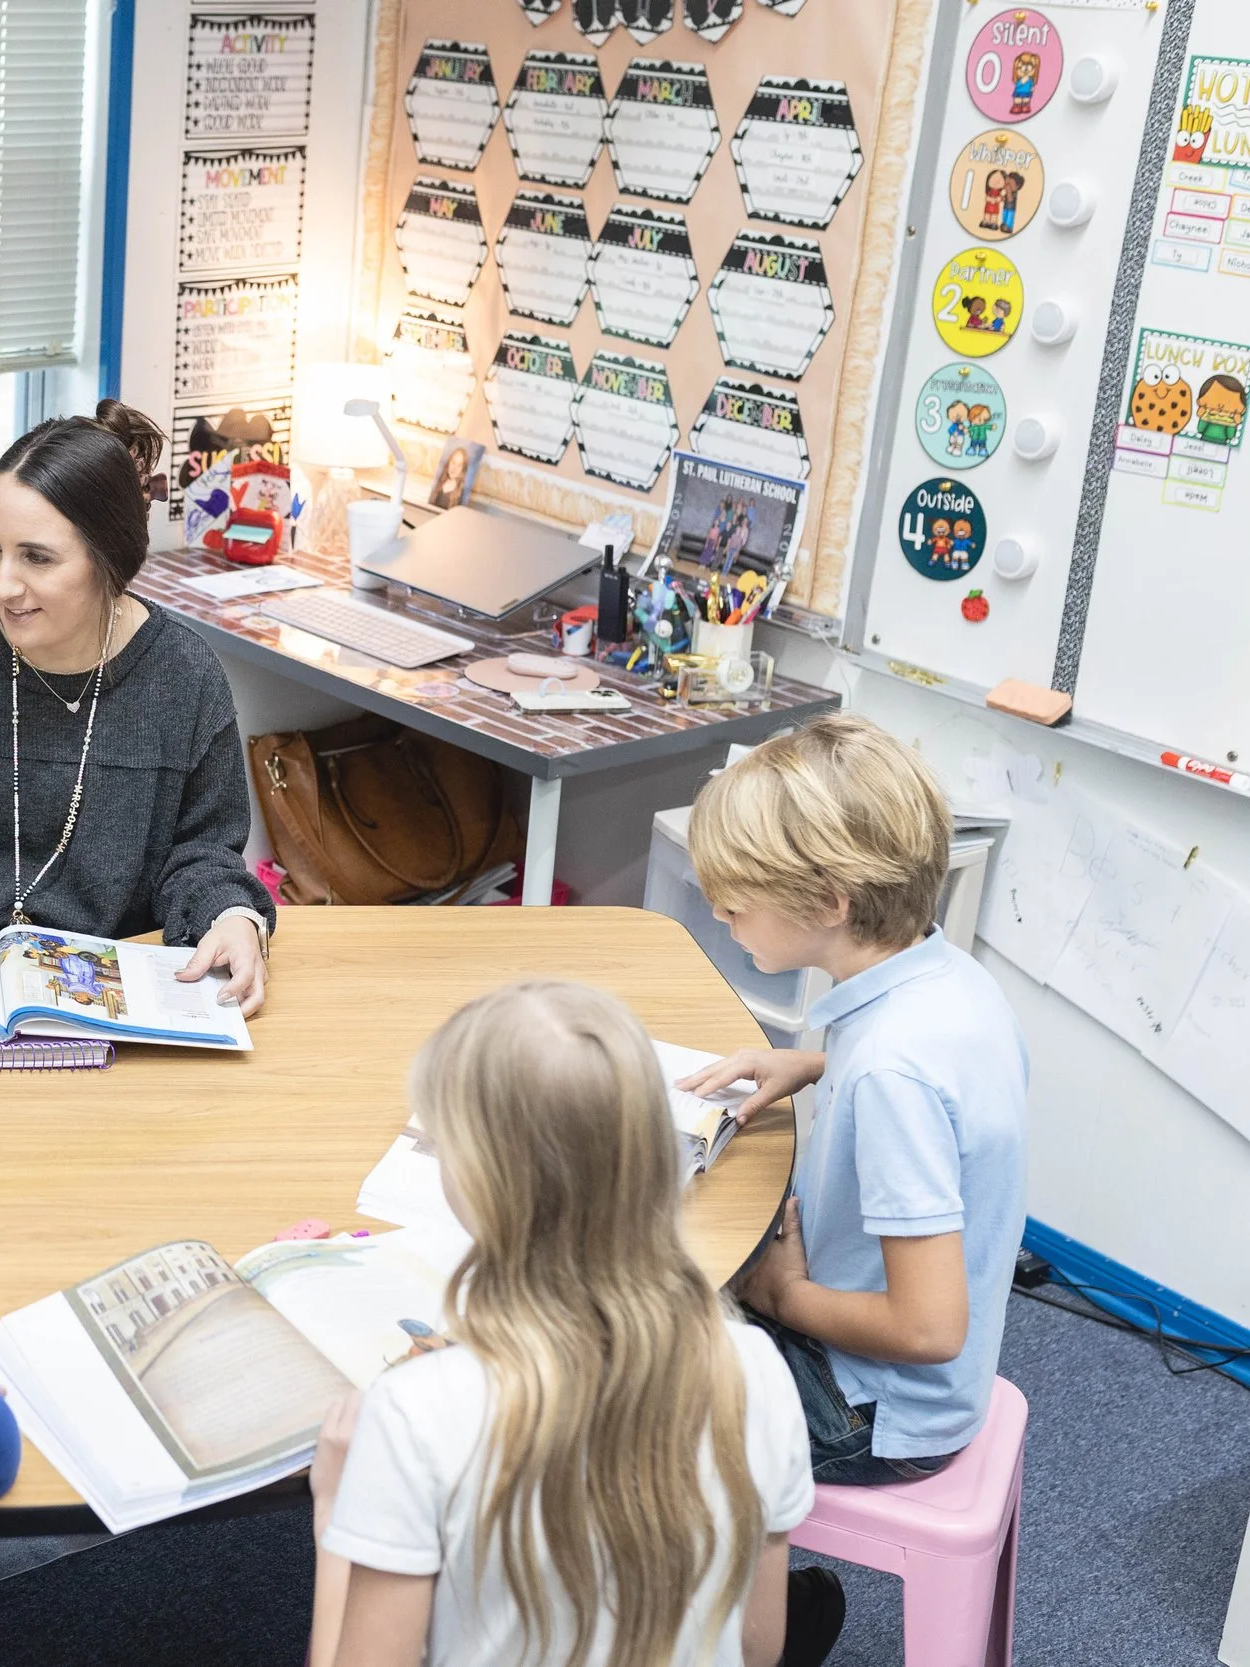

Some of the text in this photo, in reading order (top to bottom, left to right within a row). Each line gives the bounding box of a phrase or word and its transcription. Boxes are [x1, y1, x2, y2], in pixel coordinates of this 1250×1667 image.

[220, 33, 287, 54] ACTIVITY
[992, 21, 1051, 47] Silent
[526, 68, 595, 95] FEBRUARY
[975, 50, 1002, 95] 0
[637, 79, 694, 104] MARCH
[776, 98, 824, 124] APRIL
[970, 142, 1038, 169] Whisper
[205, 165, 287, 188] MOVEMENT
[430, 197, 458, 218] MAY
[530, 212, 564, 235] JUNE
[628, 227, 664, 250] JULY
[743, 250, 810, 282] AUGUST
[950, 260, 1016, 287] Partner
[937, 282, 963, 324] 2
[1145, 341, 1205, 368] LUNCH
[591, 367, 666, 402] NOVEMBER
[716, 393, 793, 431] DECEMBER
[920, 394, 942, 434] 3
[682, 461, 797, 505] ST. PAUL LUTHERAN SCHOOL
[917, 488, 974, 514] Outside
[902, 512, 926, 550] 4
